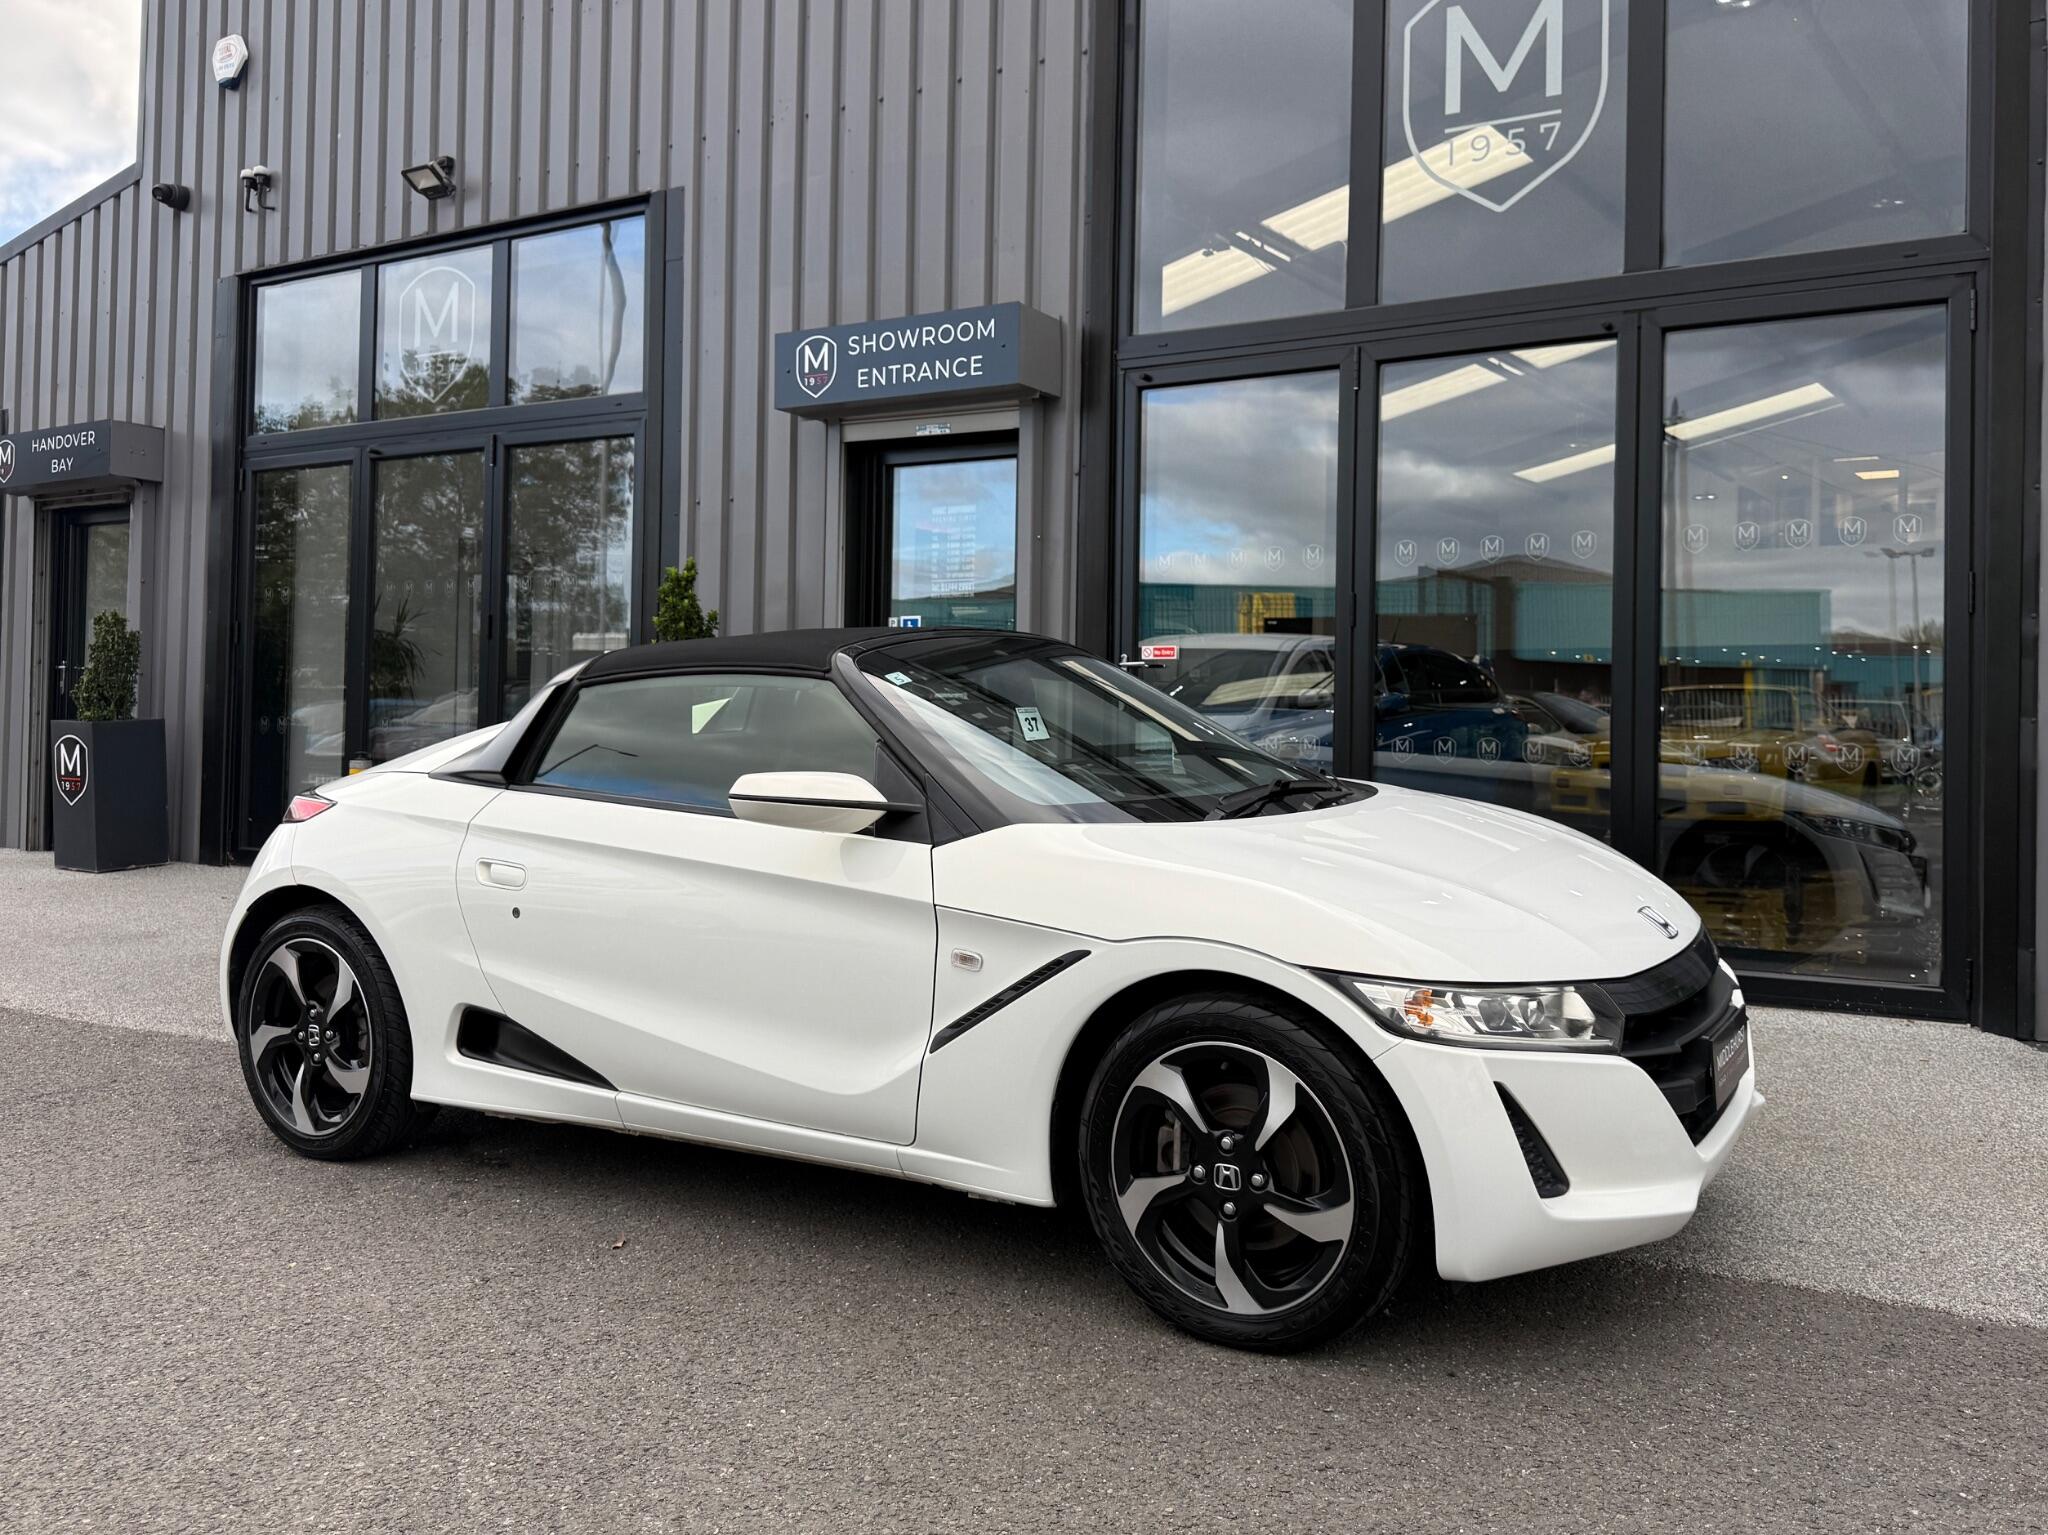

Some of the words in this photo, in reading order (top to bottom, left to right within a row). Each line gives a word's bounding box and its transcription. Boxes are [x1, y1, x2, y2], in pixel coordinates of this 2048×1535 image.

[1445, 0, 1563, 115] M
[1448, 121, 1562, 166] 1957
[414, 281, 459, 348] M
[848, 318, 995, 356] SHOWROOM
[414, 355, 457, 373] 1957
[804, 342, 829, 374] M
[857, 355, 983, 388] ENTRANCE
[804, 375, 829, 387] 1957
[31, 430, 95, 453] HANDOVER
[0, 444, 11, 466] M
[51, 457, 74, 473] BAY
[1791, 523, 1807, 537] M
[1844, 520, 1860, 535] M
[1899, 517, 1916, 532] M
[1688, 528, 1703, 542] M
[1739, 526, 1755, 539] M
[1441, 541, 1455, 553] M
[1485, 539, 1499, 553] M
[1530, 536, 1545, 550] M
[1577, 534, 1592, 548] M
[1399, 543, 1412, 556] M
[1024, 717, 1039, 732] 37
[1396, 740, 1409, 753] M
[1438, 740, 1452, 753] M
[1482, 741, 1496, 754] M
[61, 743, 81, 777] M
[1788, 747, 1804, 761] M
[1842, 748, 1859, 762] M
[61, 781, 81, 791] 1957
